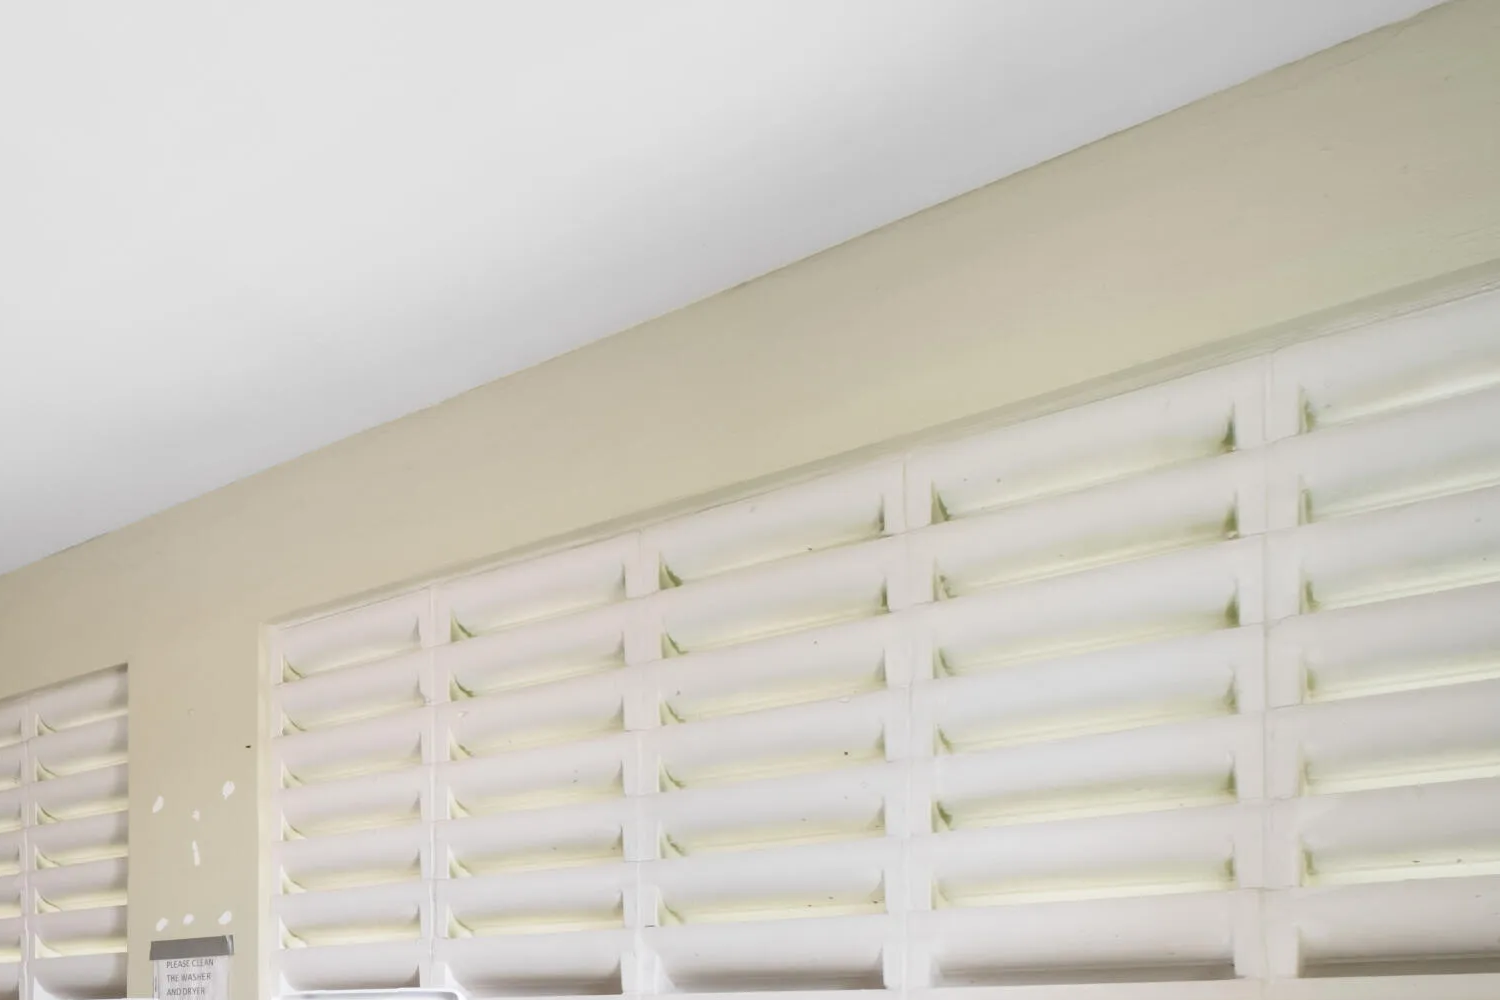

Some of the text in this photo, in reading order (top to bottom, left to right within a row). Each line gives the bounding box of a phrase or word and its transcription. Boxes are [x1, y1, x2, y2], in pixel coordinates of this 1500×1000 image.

[166, 958, 214, 969] PLEASE CLEAN
[166, 973, 212, 983] THE WASHER
[166, 986, 206, 996] AND DRYER
